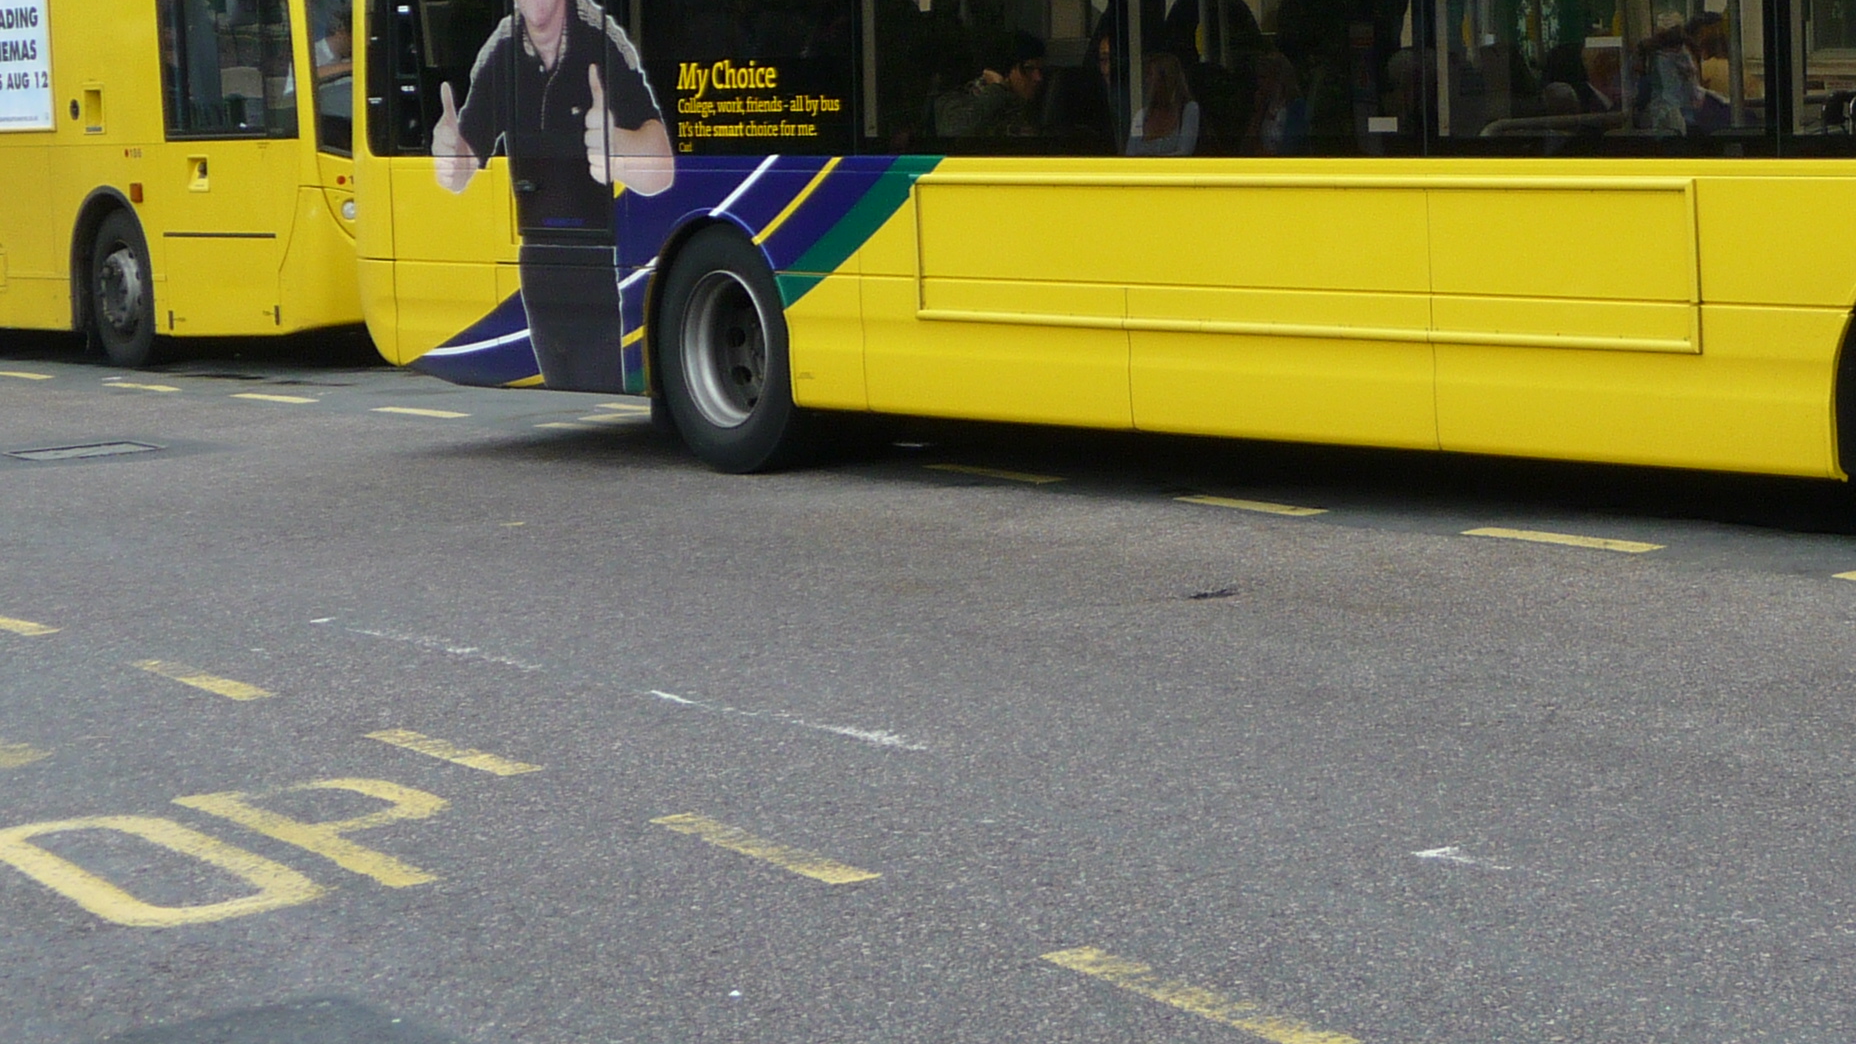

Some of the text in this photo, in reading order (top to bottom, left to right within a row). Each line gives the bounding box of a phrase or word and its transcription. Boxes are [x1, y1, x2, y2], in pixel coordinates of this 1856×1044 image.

[0, 39, 37, 62] EMAS
[7, 71, 30, 90] AUG
[34, 70, 48, 89] 12
[676, 59, 778, 98] My Choice
[677, 98, 716, 118] College,
[717, 97, 745, 115] work,
[746, 95, 783, 113] friends
[790, 95, 804, 112] all
[805, 95, 819, 117] by
[820, 95, 841, 112] bus
[695, 122, 712, 137] the
[713, 123, 744, 138] smart
[745, 120, 779, 137] choice
[780, 119, 797, 137] for
[797, 124, 818, 137] me.
